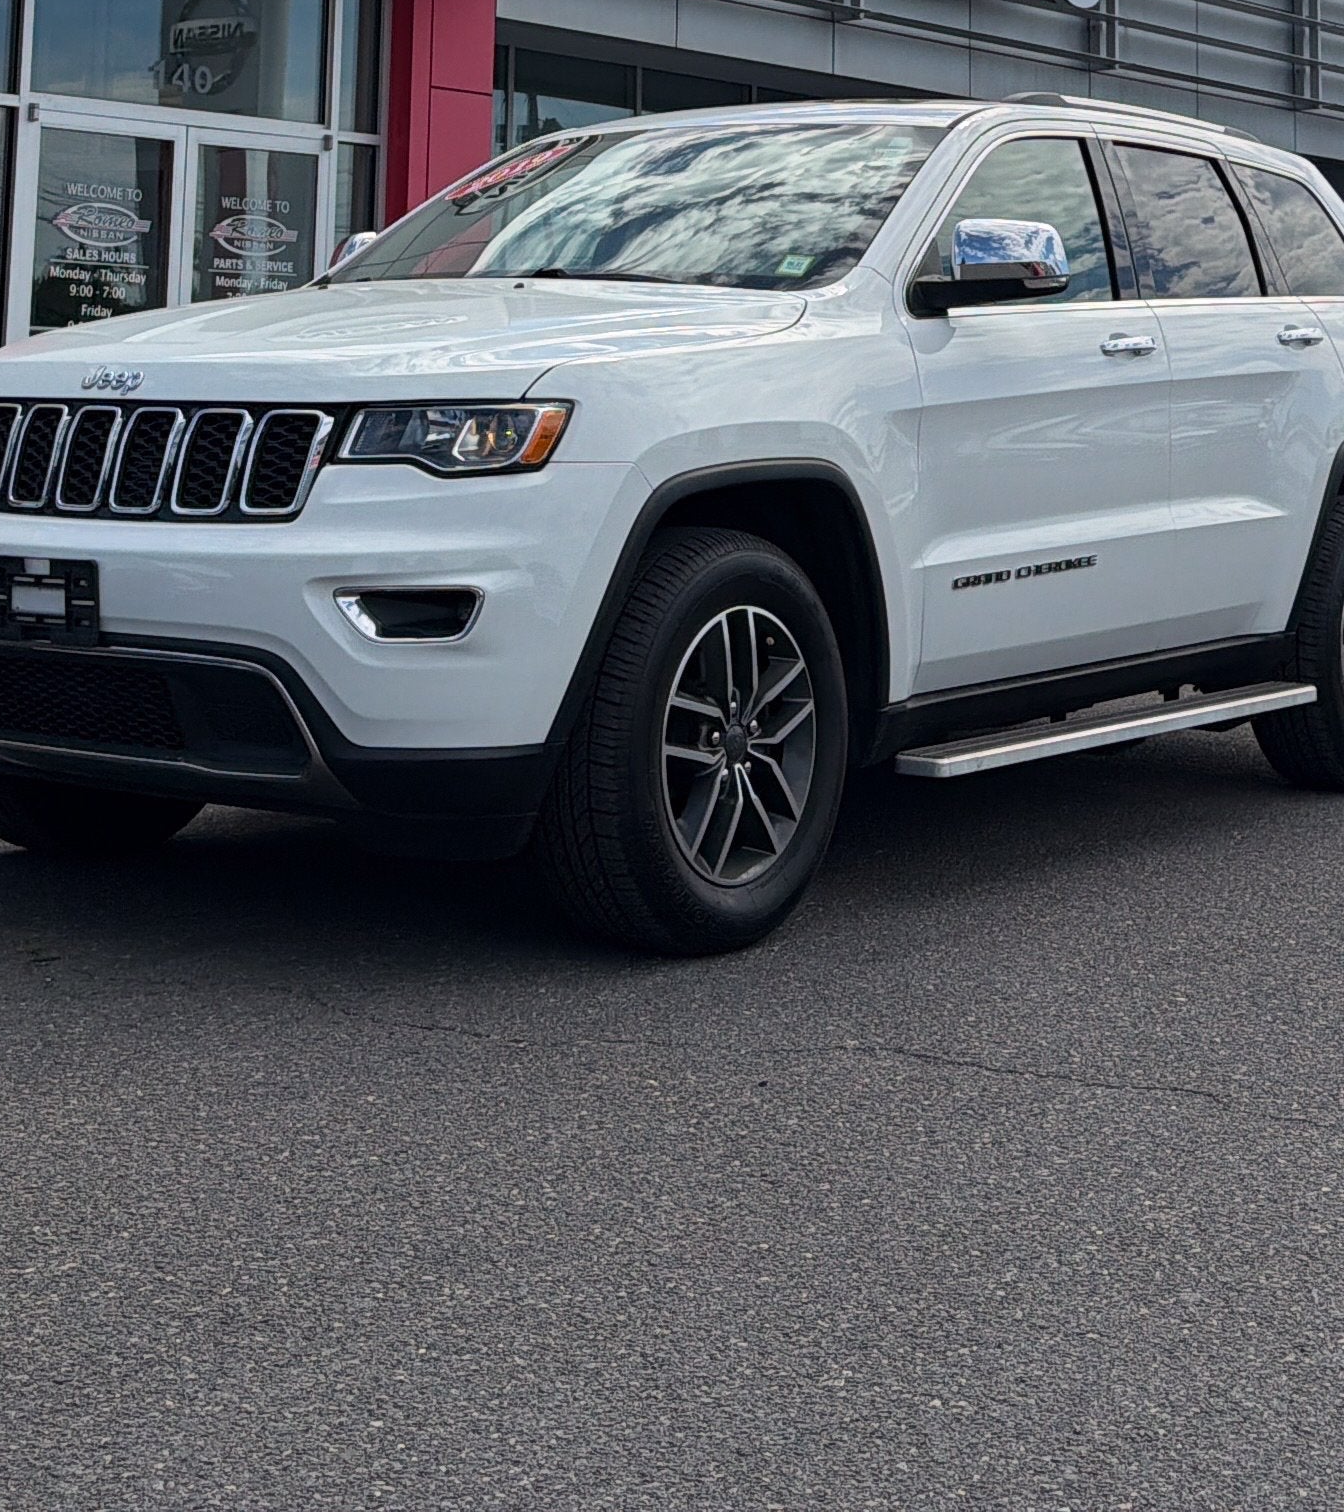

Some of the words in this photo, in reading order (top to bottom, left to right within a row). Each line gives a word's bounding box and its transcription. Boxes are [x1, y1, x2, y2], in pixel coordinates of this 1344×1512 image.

[154, 60, 213, 94] 140
[67, 182, 123, 199] WELCOME
[127, 188, 143, 202] TO
[221, 196, 272, 212] WELCOME
[275, 200, 290, 214] TO
[76, 205, 135, 228] Romeo
[79, 229, 124, 241] NISSAN
[233, 239, 274, 250] NISSAN
[66, 247, 99, 262] SALES
[101, 250, 137, 264] HOURS
[213, 257, 244, 270] PARTS
[256, 261, 294, 273] SERVICE
[50, 266, 91, 283] Monday
[100, 269, 147, 286] Thursday
[216, 275, 253, 291] Monday
[260, 277, 289, 292] Friday
[69, 284, 93, 298] 9:00
[103, 286, 126, 300] 7:00
[80, 304, 113, 318] Friday
[81, 365, 144, 396] Jeep
